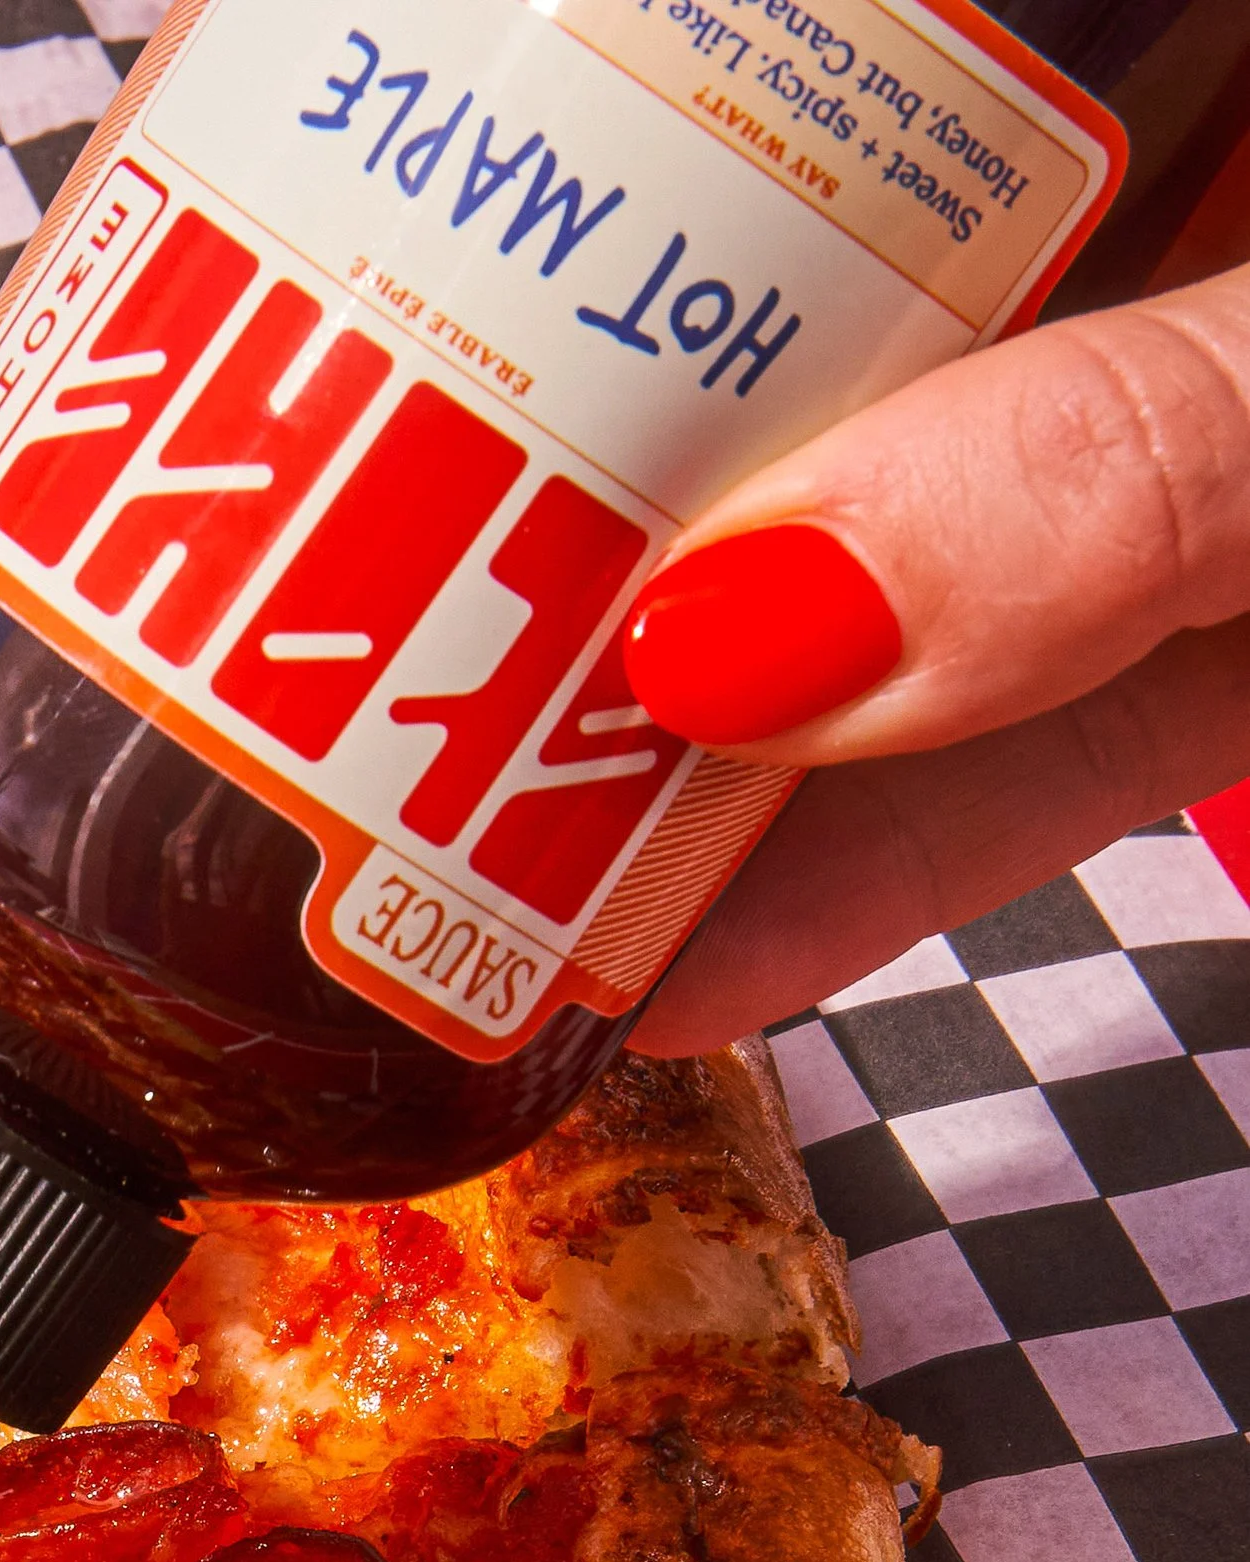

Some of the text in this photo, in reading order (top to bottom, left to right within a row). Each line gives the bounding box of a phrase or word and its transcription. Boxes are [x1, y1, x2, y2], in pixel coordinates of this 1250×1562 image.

[668, 0, 753, 73] Like
[692, 85, 841, 200] SAY WHAT?
[730, 0, 1030, 209] Honey, but Cana
[757, 53, 859, 142] spicy.
[300, 29, 801, 397] HOT MAPLE
[881, 151, 983, 243] Sweet
[427, 311, 535, 397] ÉRABLE
[357, 873, 538, 1021] SAUCE
